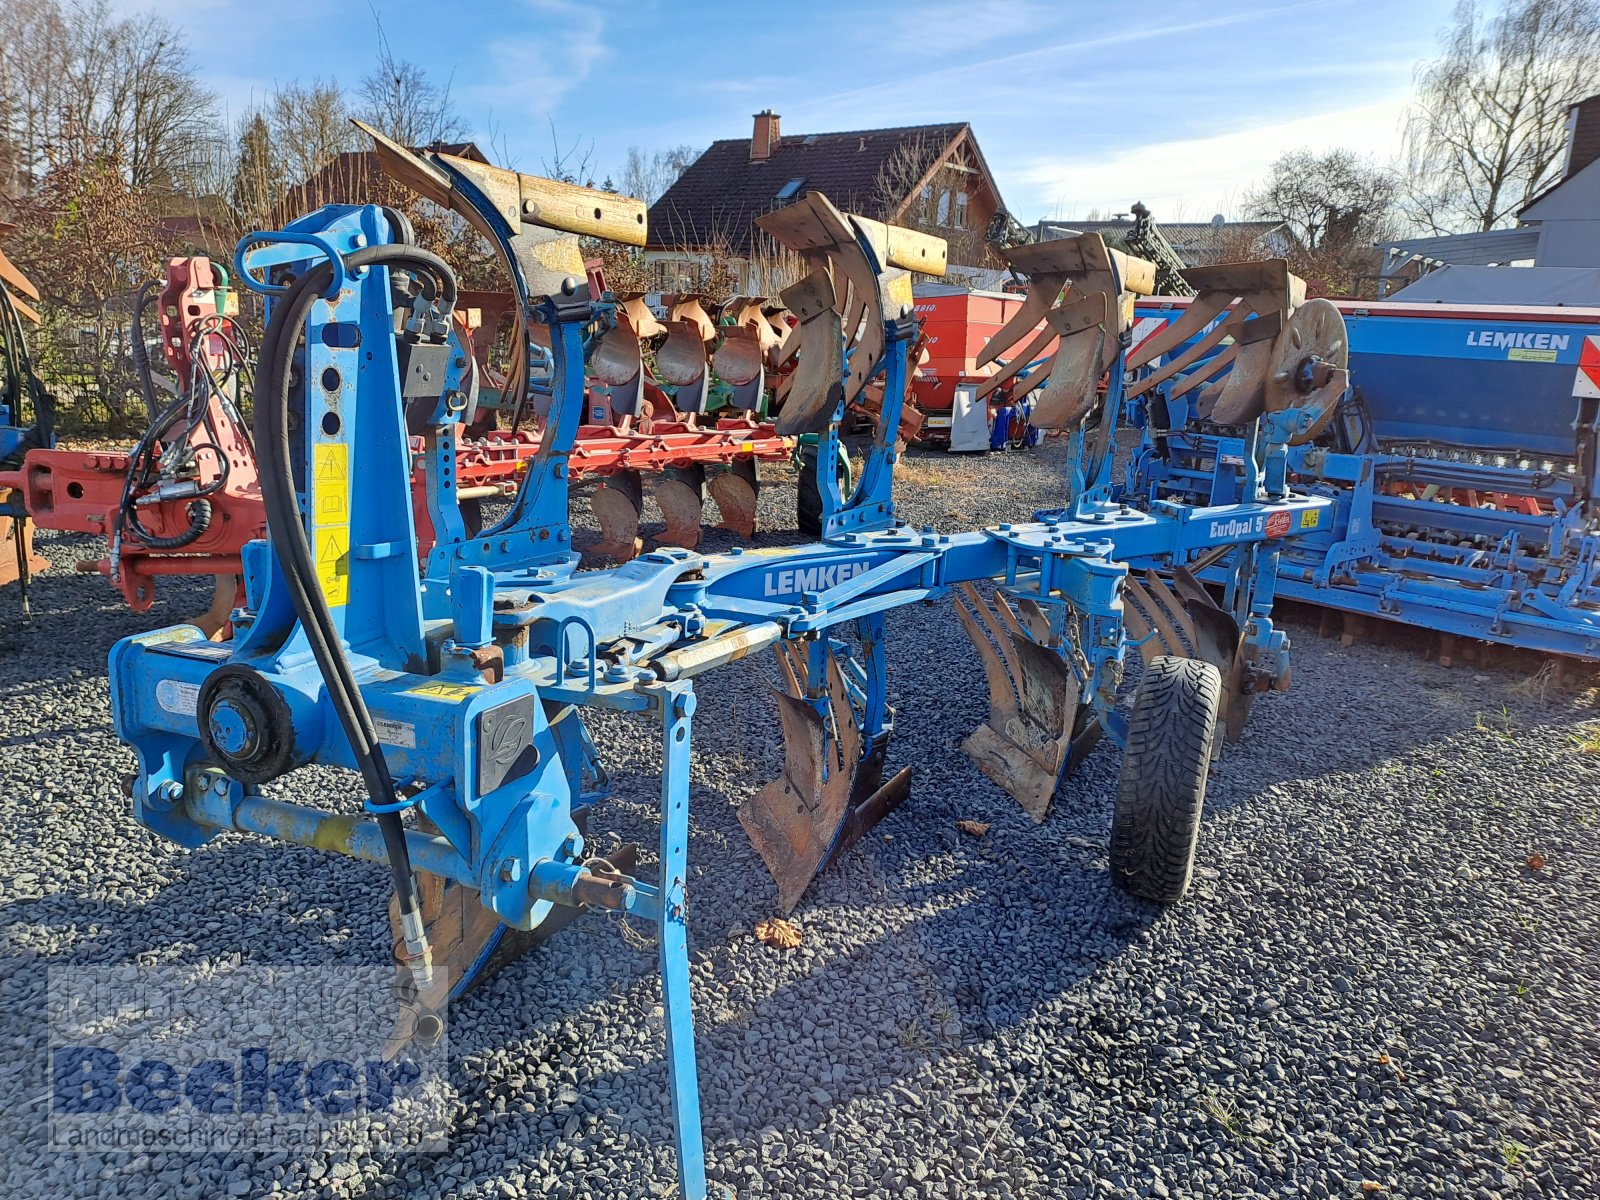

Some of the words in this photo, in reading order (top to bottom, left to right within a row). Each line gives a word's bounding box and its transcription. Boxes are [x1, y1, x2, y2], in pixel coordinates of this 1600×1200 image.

[1466, 331, 1570, 351] LEMKEN
[1210, 517, 1252, 539] EurOpal
[1255, 516, 1264, 532] 5
